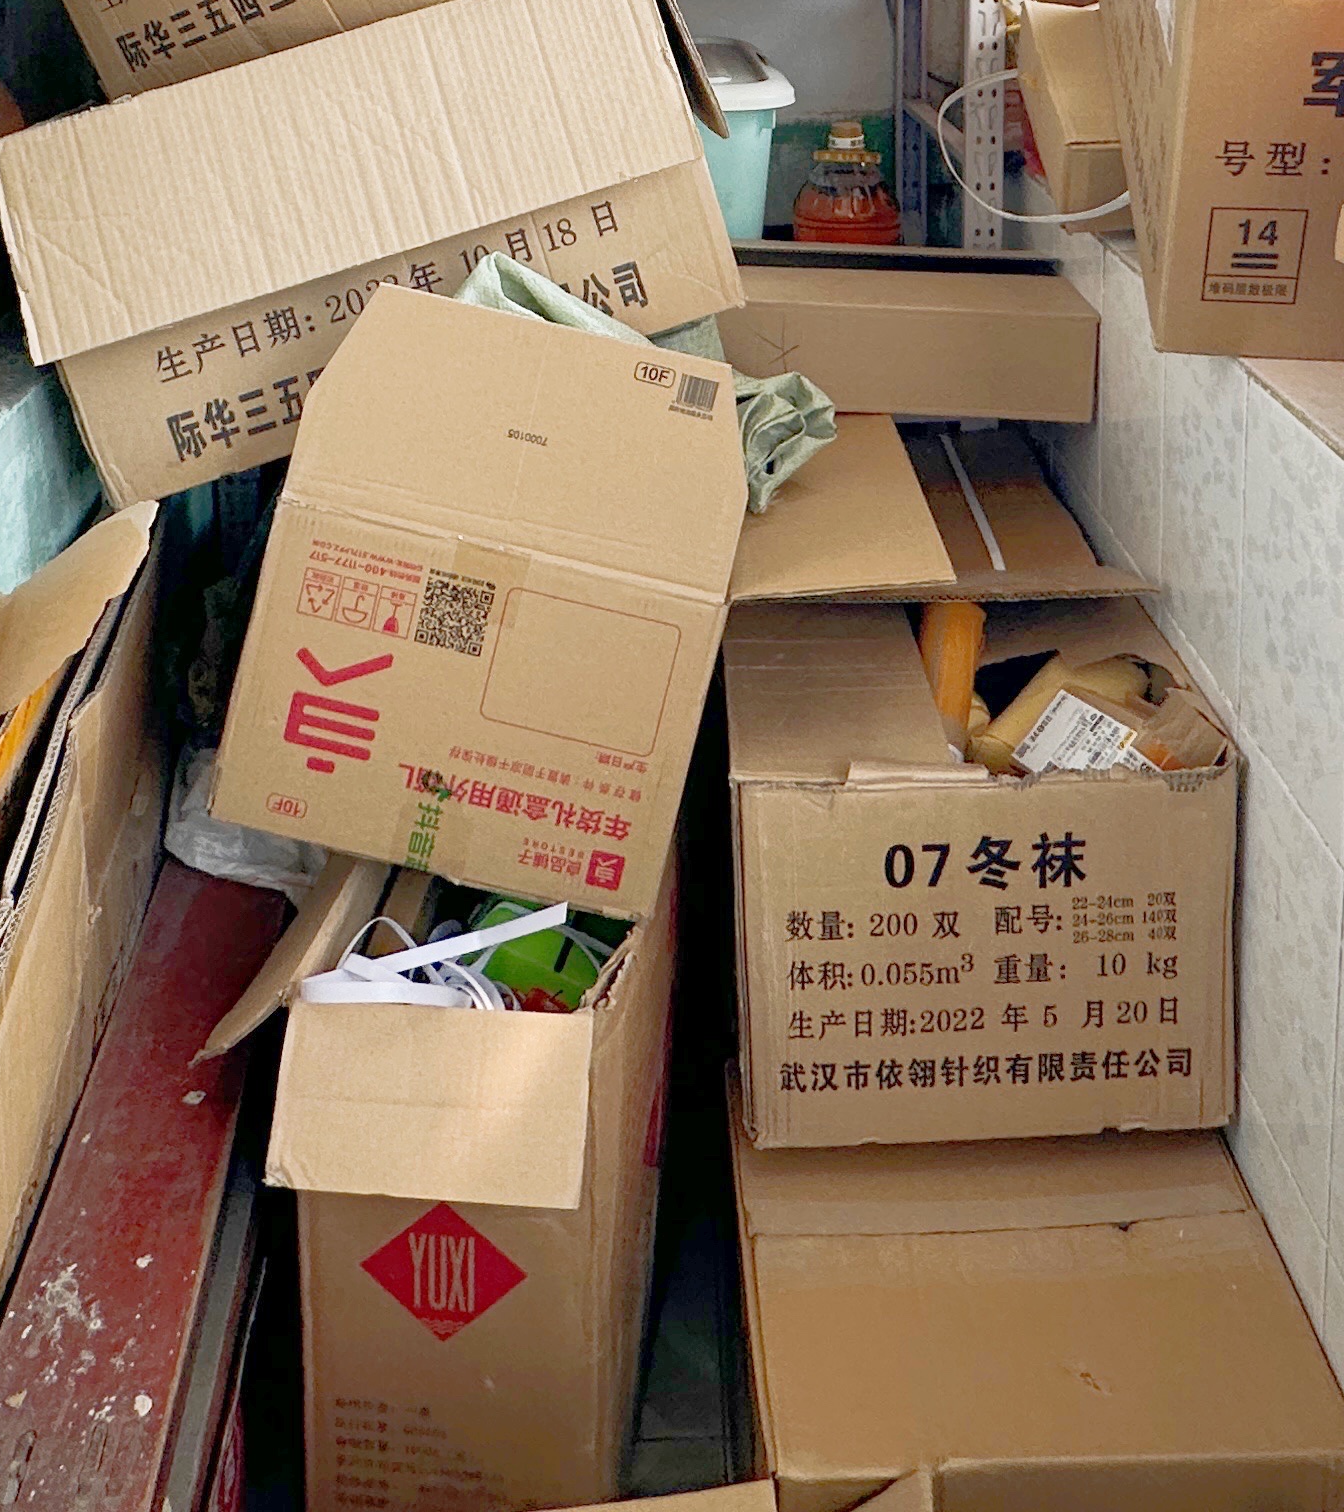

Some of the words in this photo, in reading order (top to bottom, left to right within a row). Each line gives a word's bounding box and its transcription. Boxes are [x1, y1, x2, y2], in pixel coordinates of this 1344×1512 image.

[542, 217, 579, 253] 18
[591, 200, 621, 238] 日
[1238, 219, 1279, 246] 14
[555, 260, 651, 318] 公司
[641, 364, 671, 384] 10F
[166, 367, 326, 463] 际华三五
[784, 910, 855, 942] 数量:
[870, 912, 919, 939] 200
[932, 911, 960, 940] 双
[995, 903, 1063, 937] 配号:
[1096, 952, 1127, 978] 10
[1145, 951, 1179, 981] kg
[1001, 1005, 1031, 1034] 年
[1042, 1003, 1058, 1029] 5
[1081, 998, 1105, 1030] 月
[1116, 999, 1150, 1026] 20
[1159, 995, 1179, 1027] 日
[779, 1045, 1195, 1095] 武汉市依翎针织有限责任公司
[408, 1232, 476, 1313] YUXI
